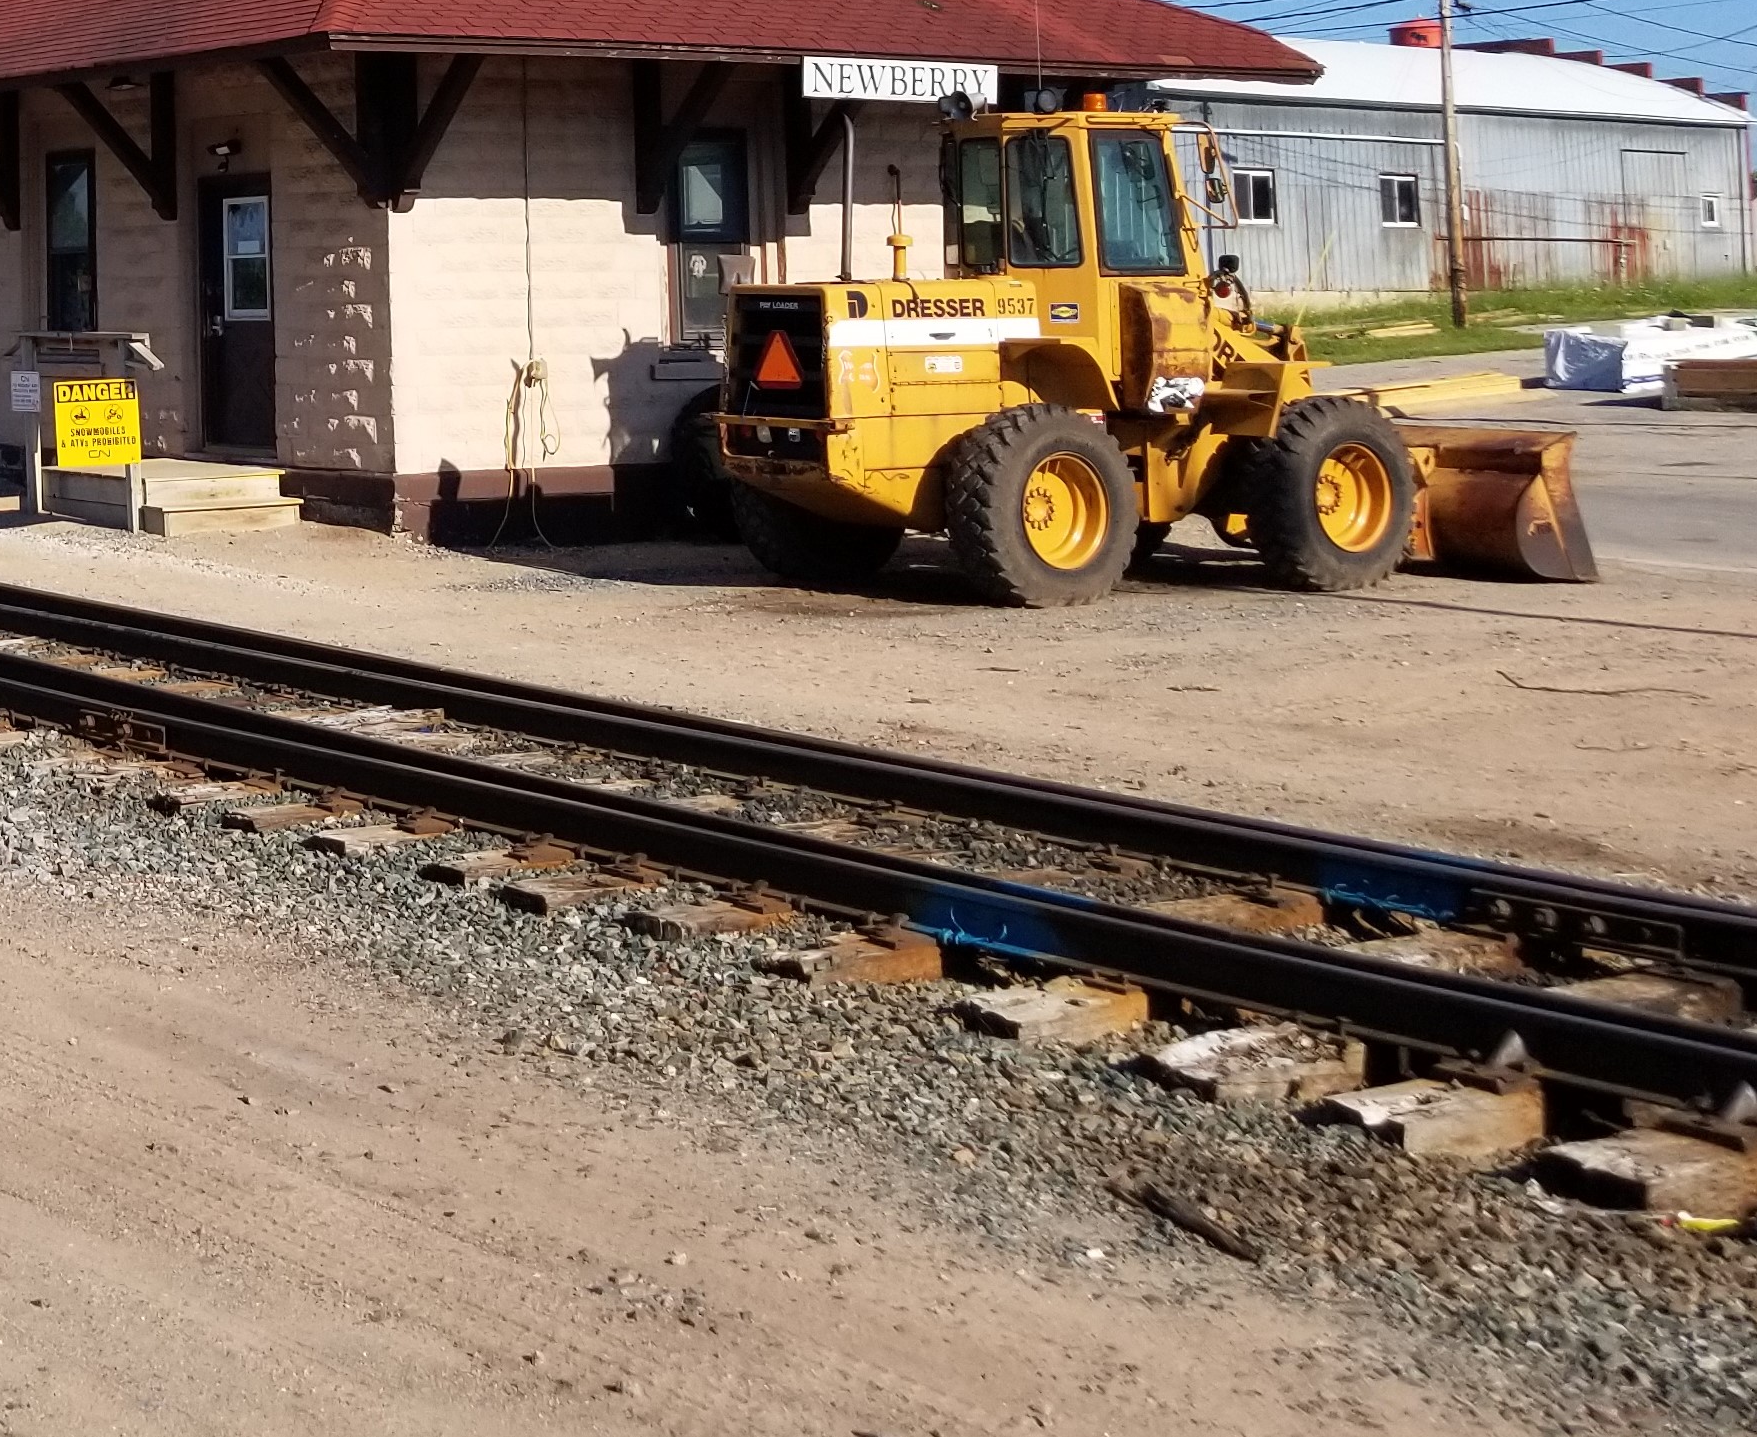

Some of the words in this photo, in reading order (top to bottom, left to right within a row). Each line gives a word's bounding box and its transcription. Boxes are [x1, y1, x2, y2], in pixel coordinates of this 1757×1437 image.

[811, 62, 990, 97] NEWBERRY
[772, 301, 799, 309] LOADER
[891, 297, 986, 318] DRESSER
[997, 297, 1035, 315] 9537
[70, 425, 126, 437] SNOWMOBILES
[92, 436, 137, 447] PROHIBITED
[88, 449, 111, 458] CN
